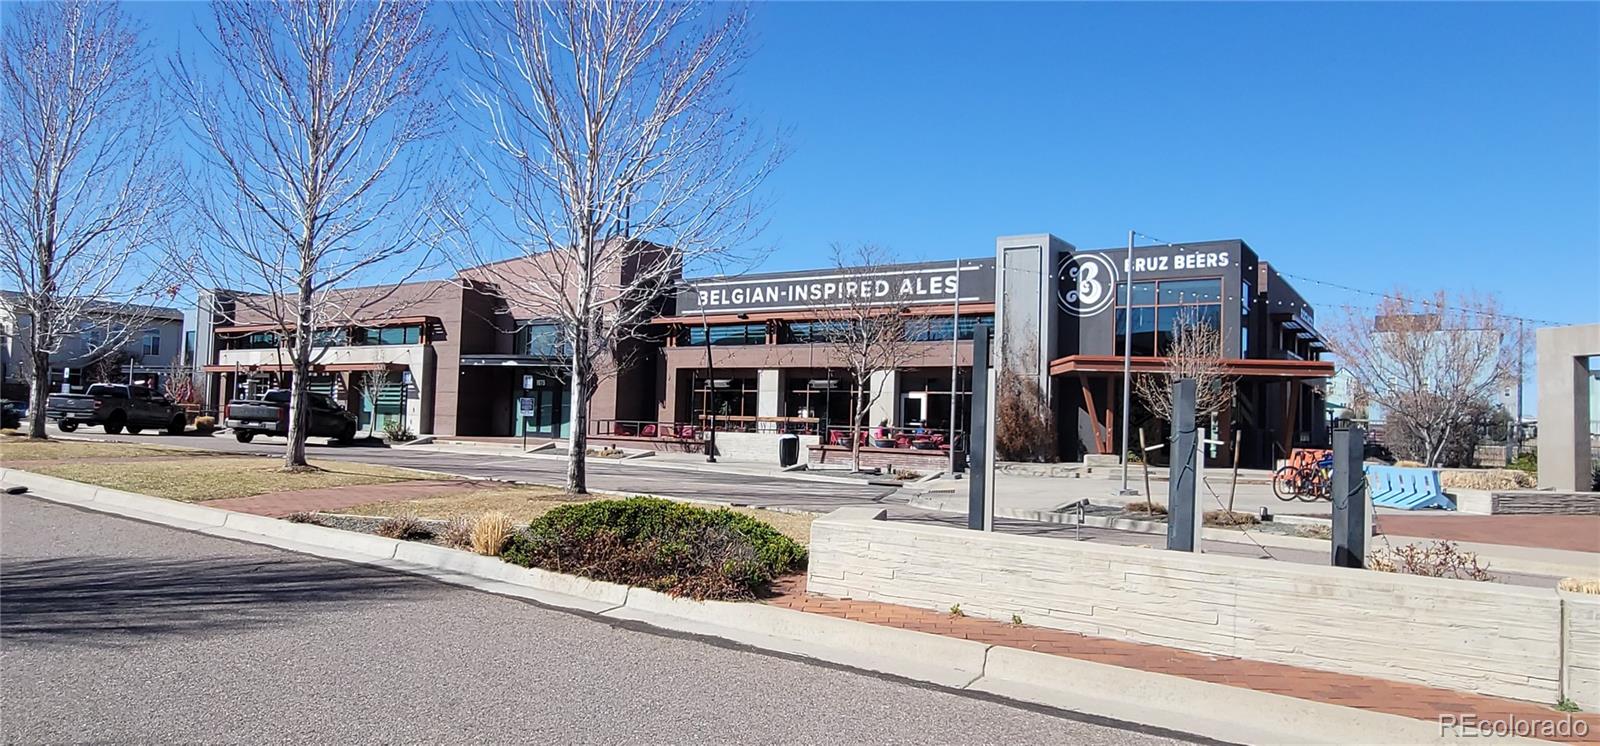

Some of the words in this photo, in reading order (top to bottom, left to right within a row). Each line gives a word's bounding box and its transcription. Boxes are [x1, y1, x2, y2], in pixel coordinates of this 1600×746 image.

[1124, 256, 1168, 272] BRUZ
[1174, 252, 1229, 269] BEERS
[697, 281, 889, 305] BELGIAN-INSPIRED
[899, 275, 959, 296] ALES
